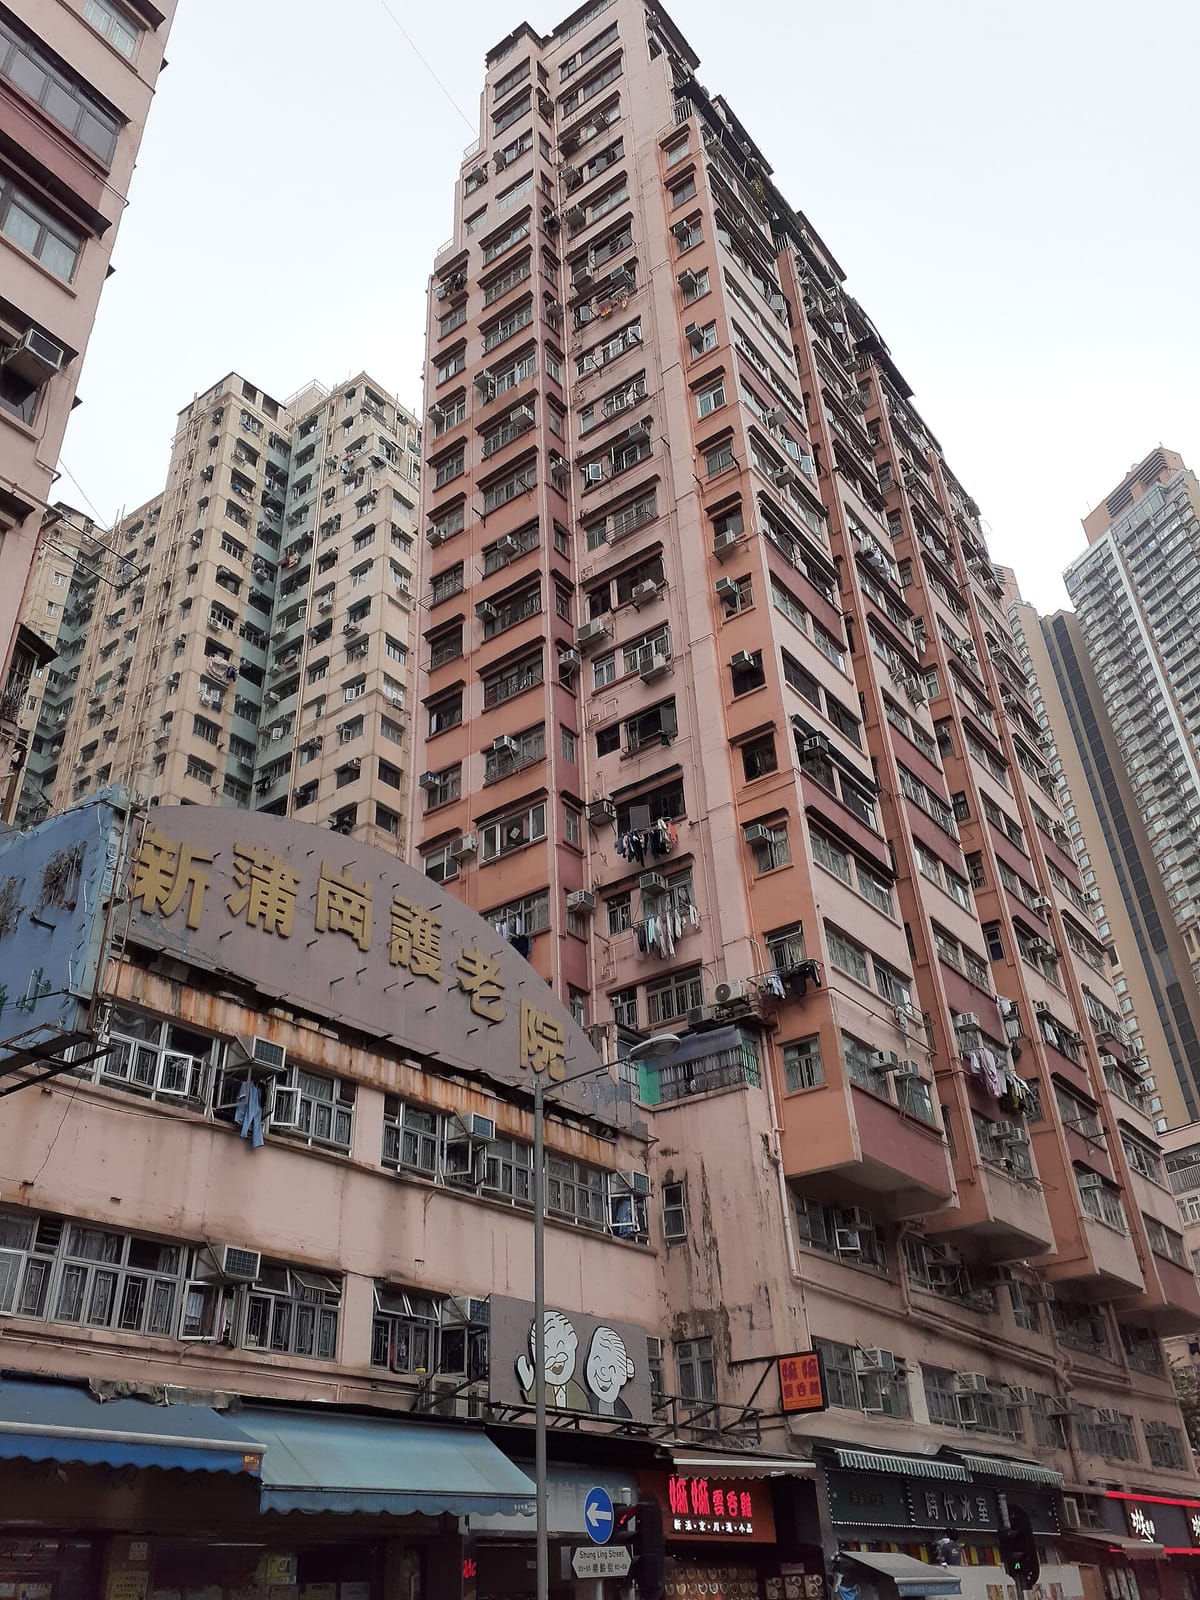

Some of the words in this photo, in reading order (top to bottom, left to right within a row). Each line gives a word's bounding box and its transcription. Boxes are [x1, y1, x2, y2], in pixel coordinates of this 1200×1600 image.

[131, 826, 567, 1083] 新蒲崗護老院
[925, 1490, 990, 1522] 時代冰室
[579, 1550, 596, 1560] Shung
[597, 1549, 608, 1560] Ling
[608, 1549, 625, 1558] Street
